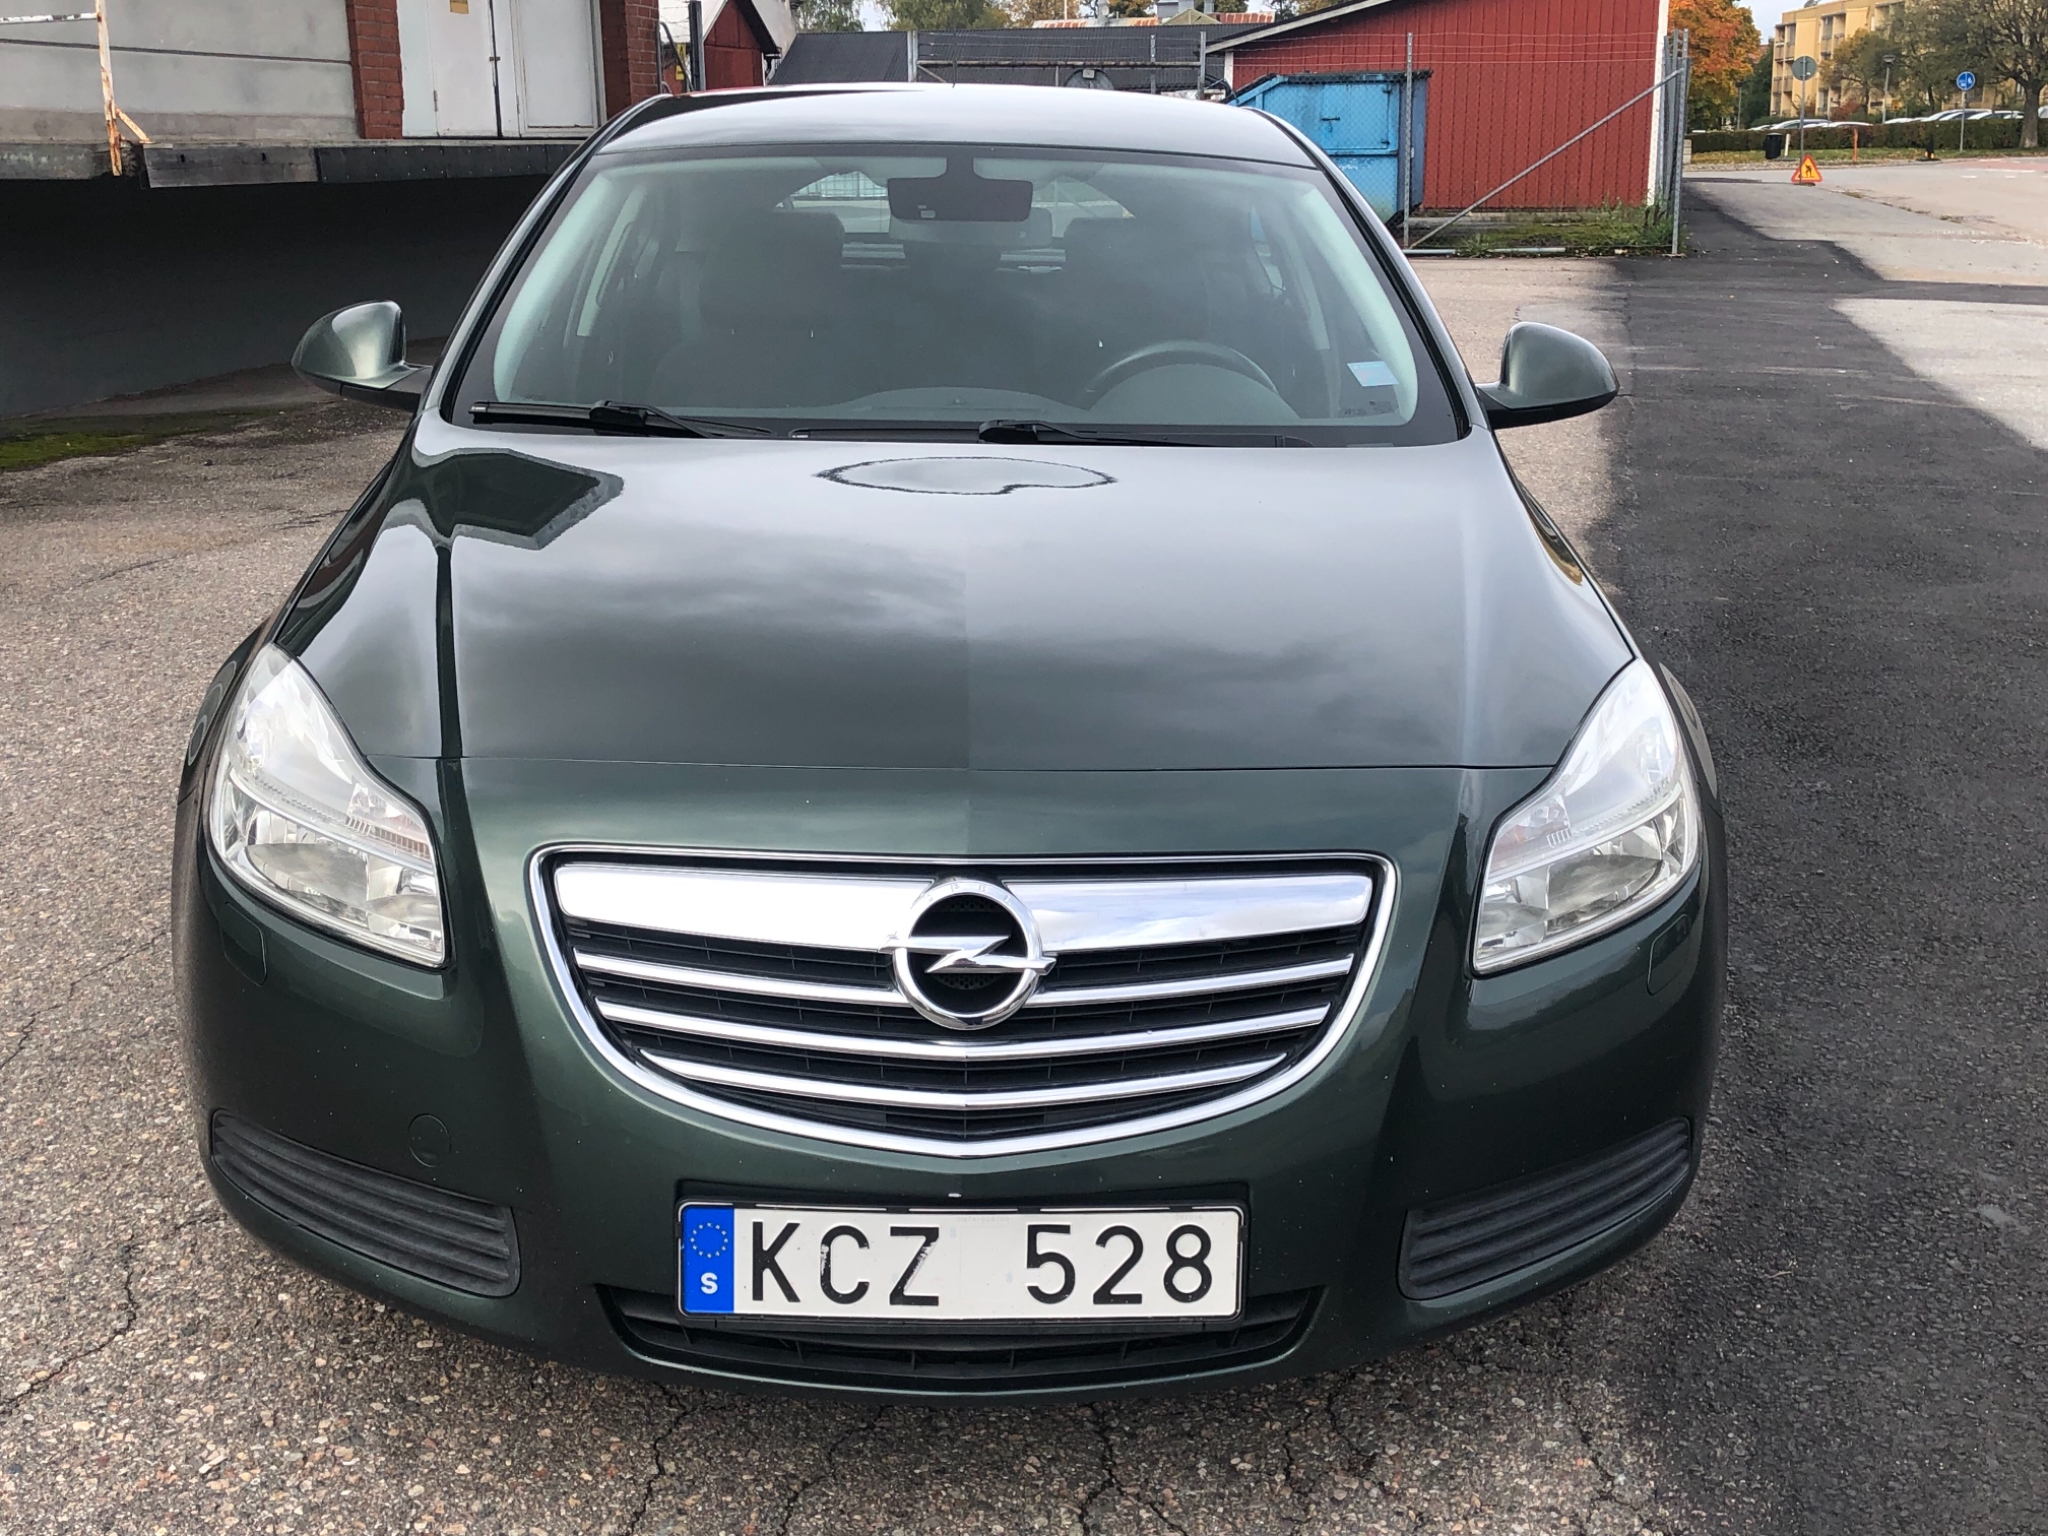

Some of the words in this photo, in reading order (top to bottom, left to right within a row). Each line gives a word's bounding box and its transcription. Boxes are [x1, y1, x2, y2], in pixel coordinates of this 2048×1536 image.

[701, 1272, 718, 1294] S
[752, 1222, 940, 1306] KCZ
[1026, 1224, 1213, 1305] 528
